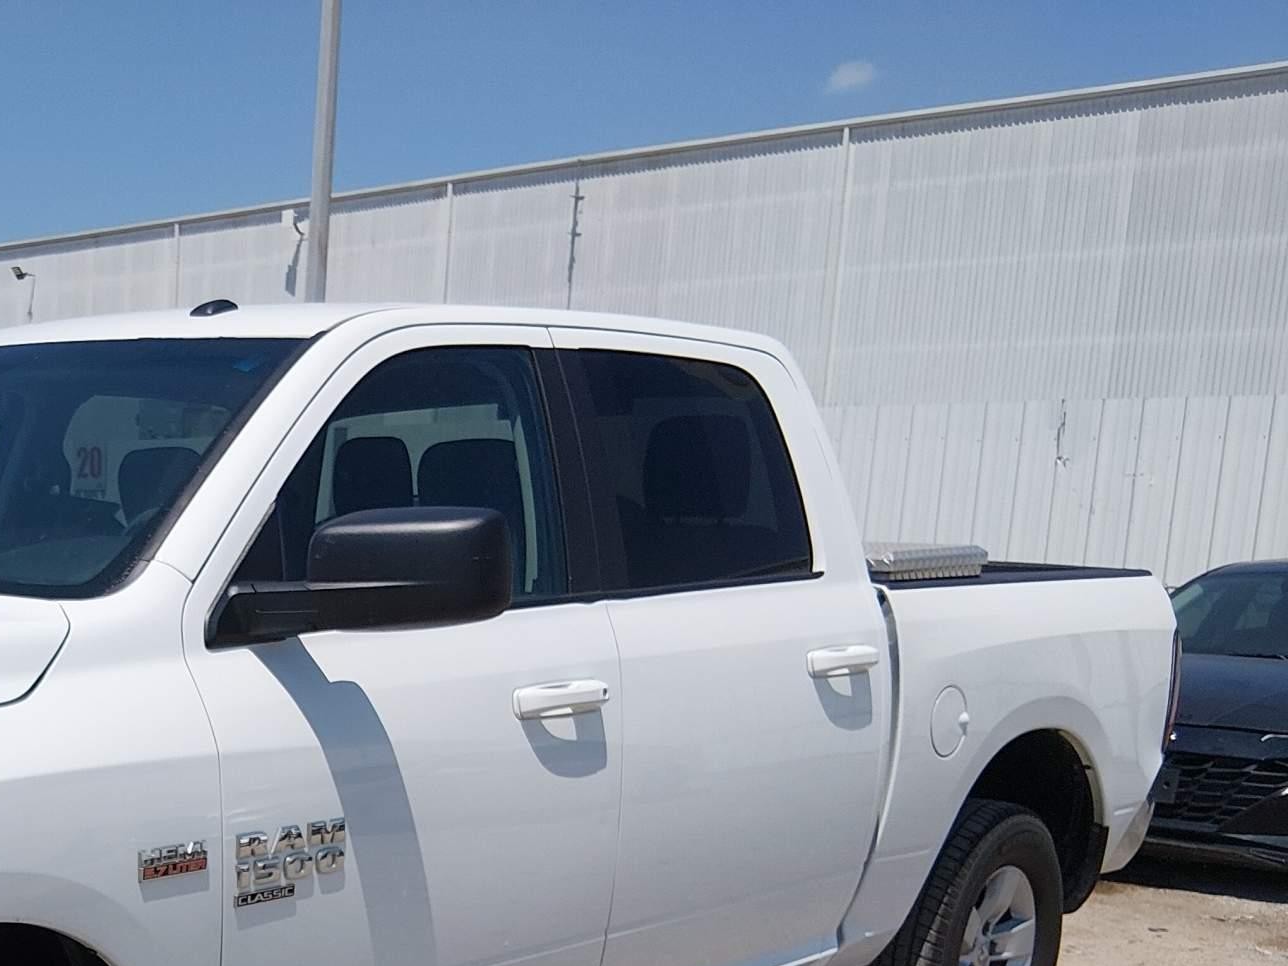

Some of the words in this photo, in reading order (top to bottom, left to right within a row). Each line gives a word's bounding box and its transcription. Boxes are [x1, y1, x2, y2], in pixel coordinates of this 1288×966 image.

[77, 446, 102, 479] 20
[139, 840, 207, 868] HEMI
[236, 818, 346, 860] RAM
[236, 846, 346, 892] 1500
[237, 886, 295, 907] CLASSIC
